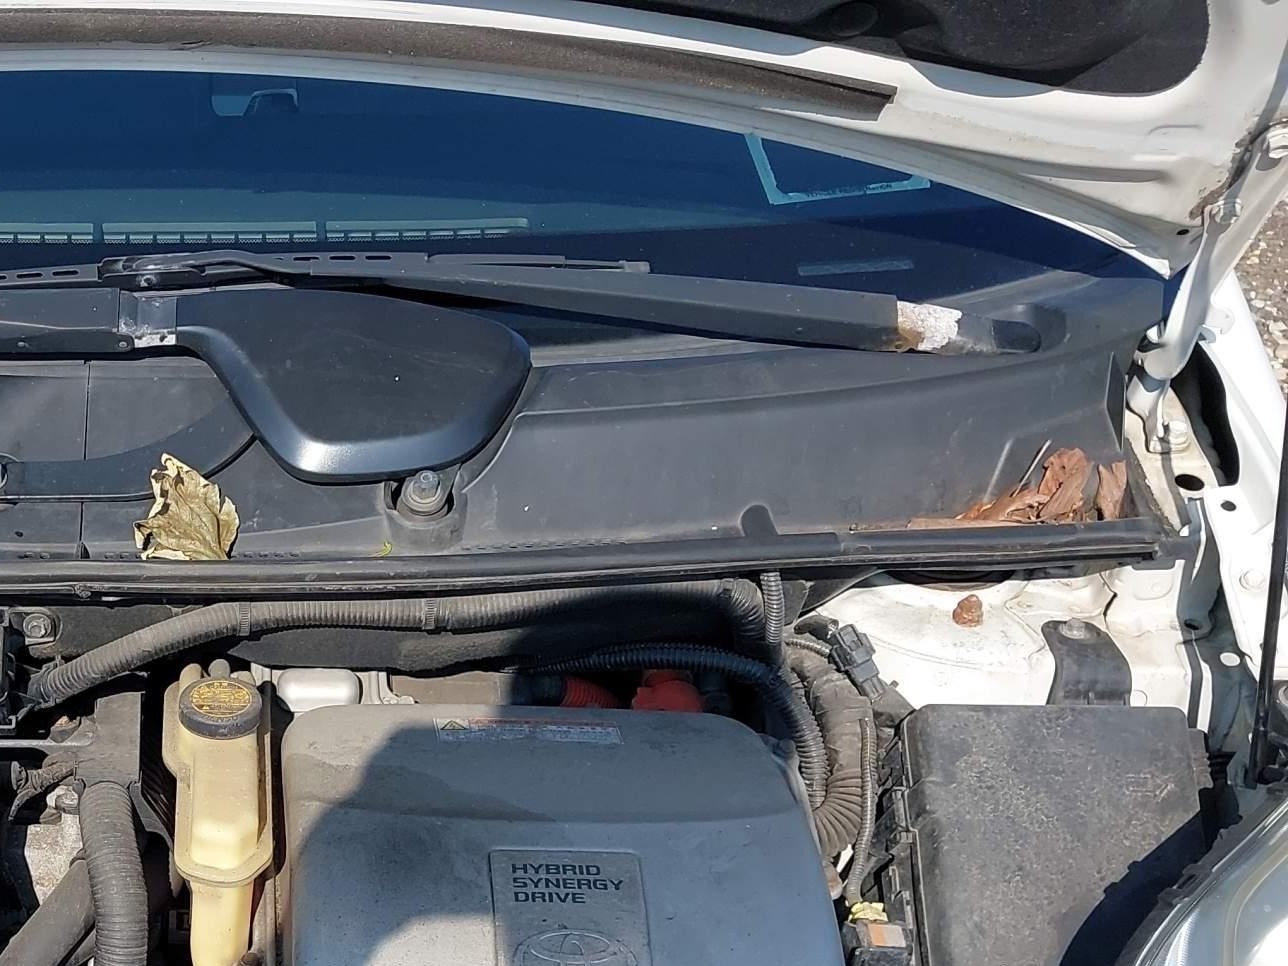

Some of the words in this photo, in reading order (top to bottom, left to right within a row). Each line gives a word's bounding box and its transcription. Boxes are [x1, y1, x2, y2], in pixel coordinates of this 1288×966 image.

[511, 863, 601, 876] HYBRID
[513, 877, 623, 891] SYNERGY
[514, 891, 586, 904] DRIVE
